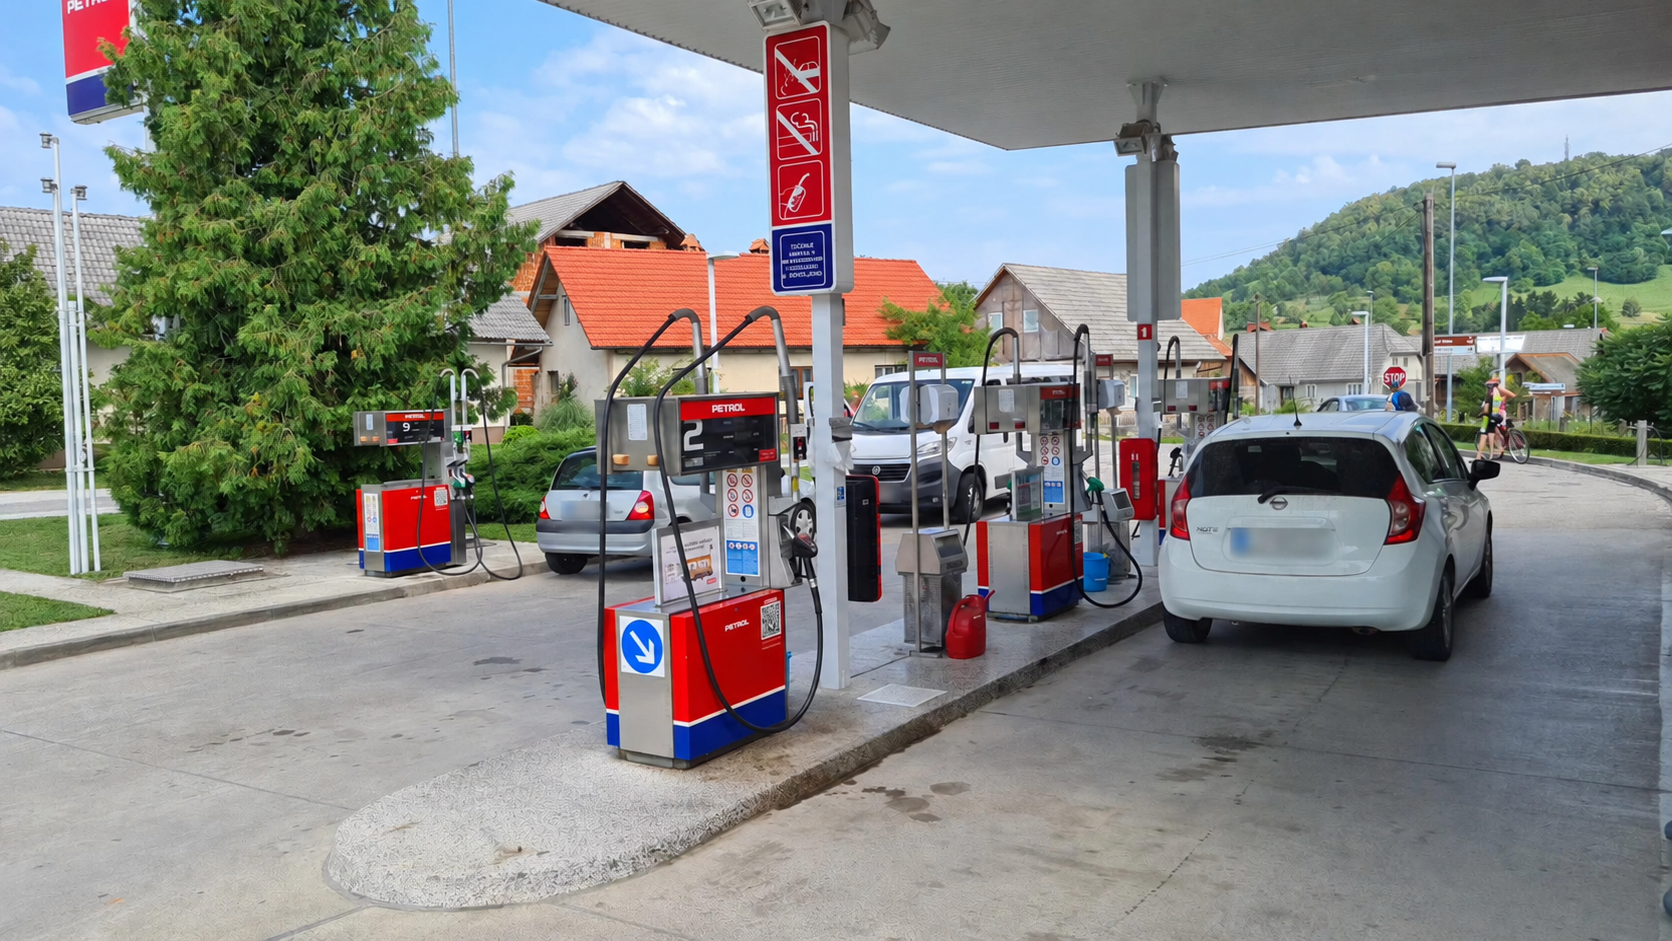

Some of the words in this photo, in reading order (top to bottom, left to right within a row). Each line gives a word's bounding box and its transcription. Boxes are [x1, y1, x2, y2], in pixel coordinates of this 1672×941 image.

[1141, 327, 1147, 338] 1
[1384, 372, 1405, 384] STOP
[711, 403, 746, 413] PETROL
[402, 422, 410, 432] 9
[683, 419, 704, 451] 2
[724, 619, 750, 632] PETROL
